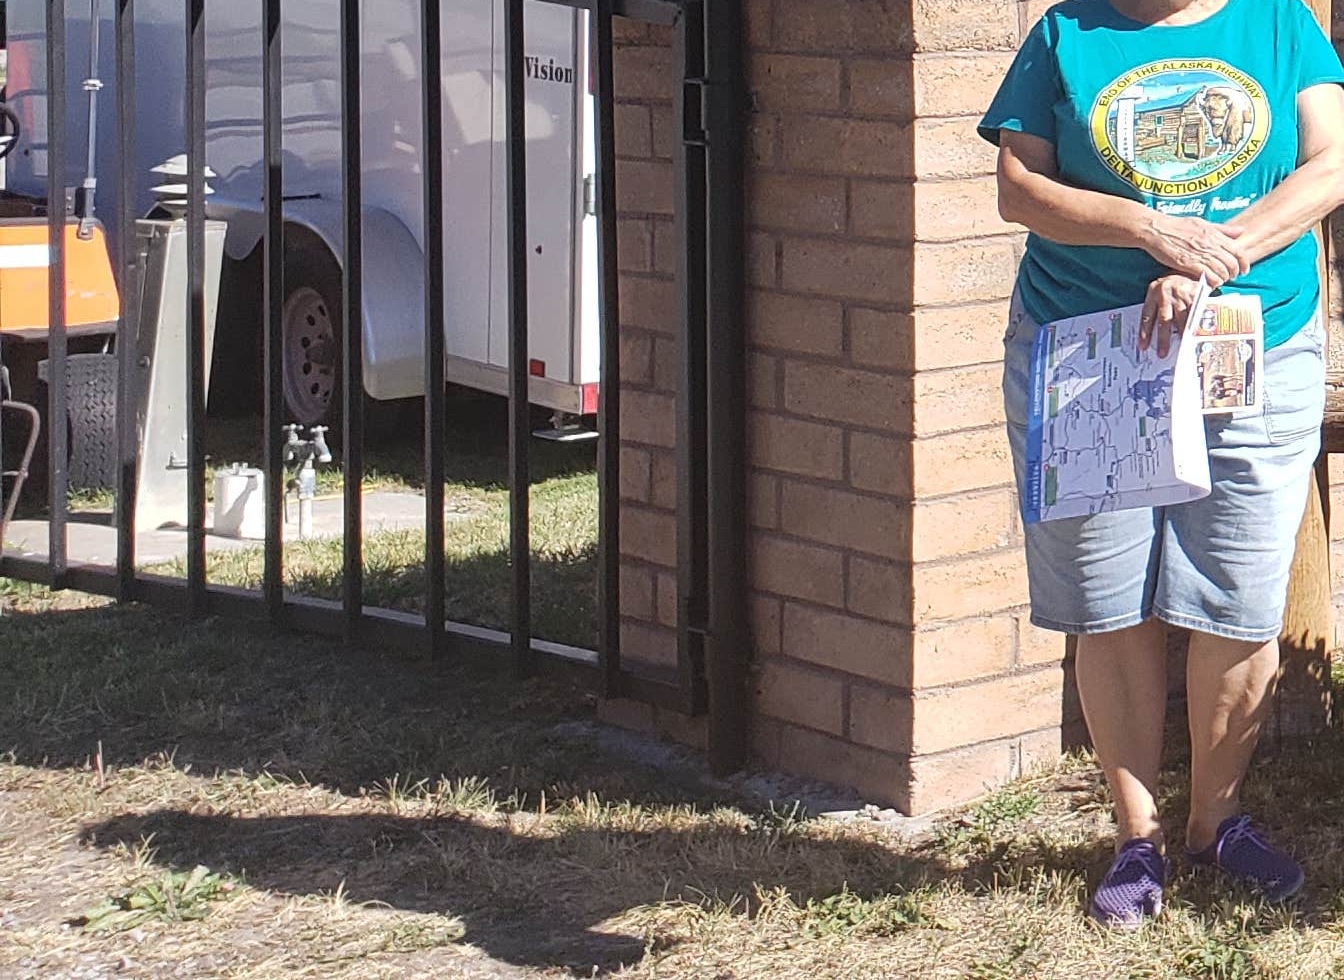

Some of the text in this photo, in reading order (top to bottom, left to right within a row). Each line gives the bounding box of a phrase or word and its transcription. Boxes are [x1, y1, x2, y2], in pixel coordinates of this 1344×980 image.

[524, 56, 572, 83] Vision
[1098, 61, 1262, 107] END OF THE ALASKA HIGHWAY
[1100, 138, 1261, 194] DELTA JUNCTION, ALASKA
